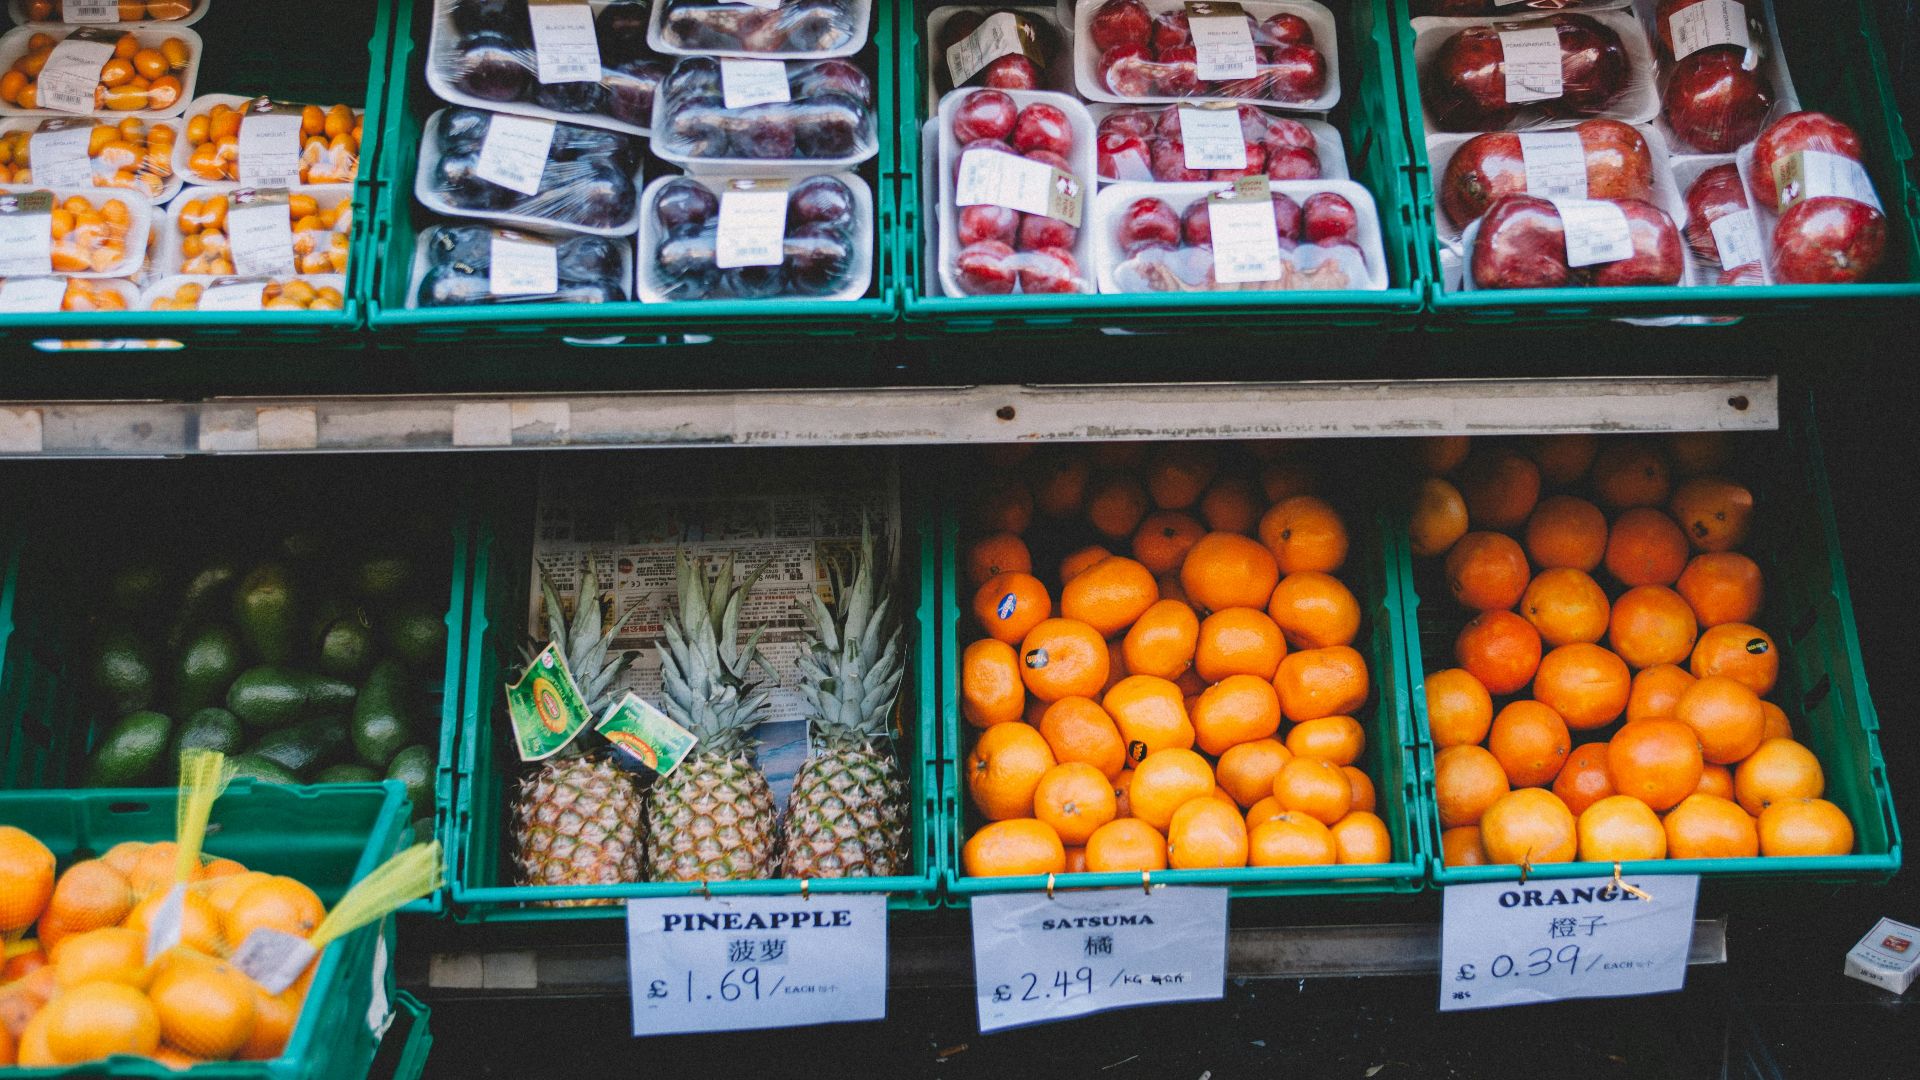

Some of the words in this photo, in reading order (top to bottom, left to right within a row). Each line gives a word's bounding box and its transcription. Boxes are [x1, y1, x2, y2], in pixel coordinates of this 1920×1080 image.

[1498, 884, 1641, 908] ORANGE
[662, 910, 852, 932] PINEAPPLE
[1042, 914, 1155, 931] SATSUMA
[1548, 914, 1608, 939] 橙子
[728, 939, 787, 962] 菠萝
